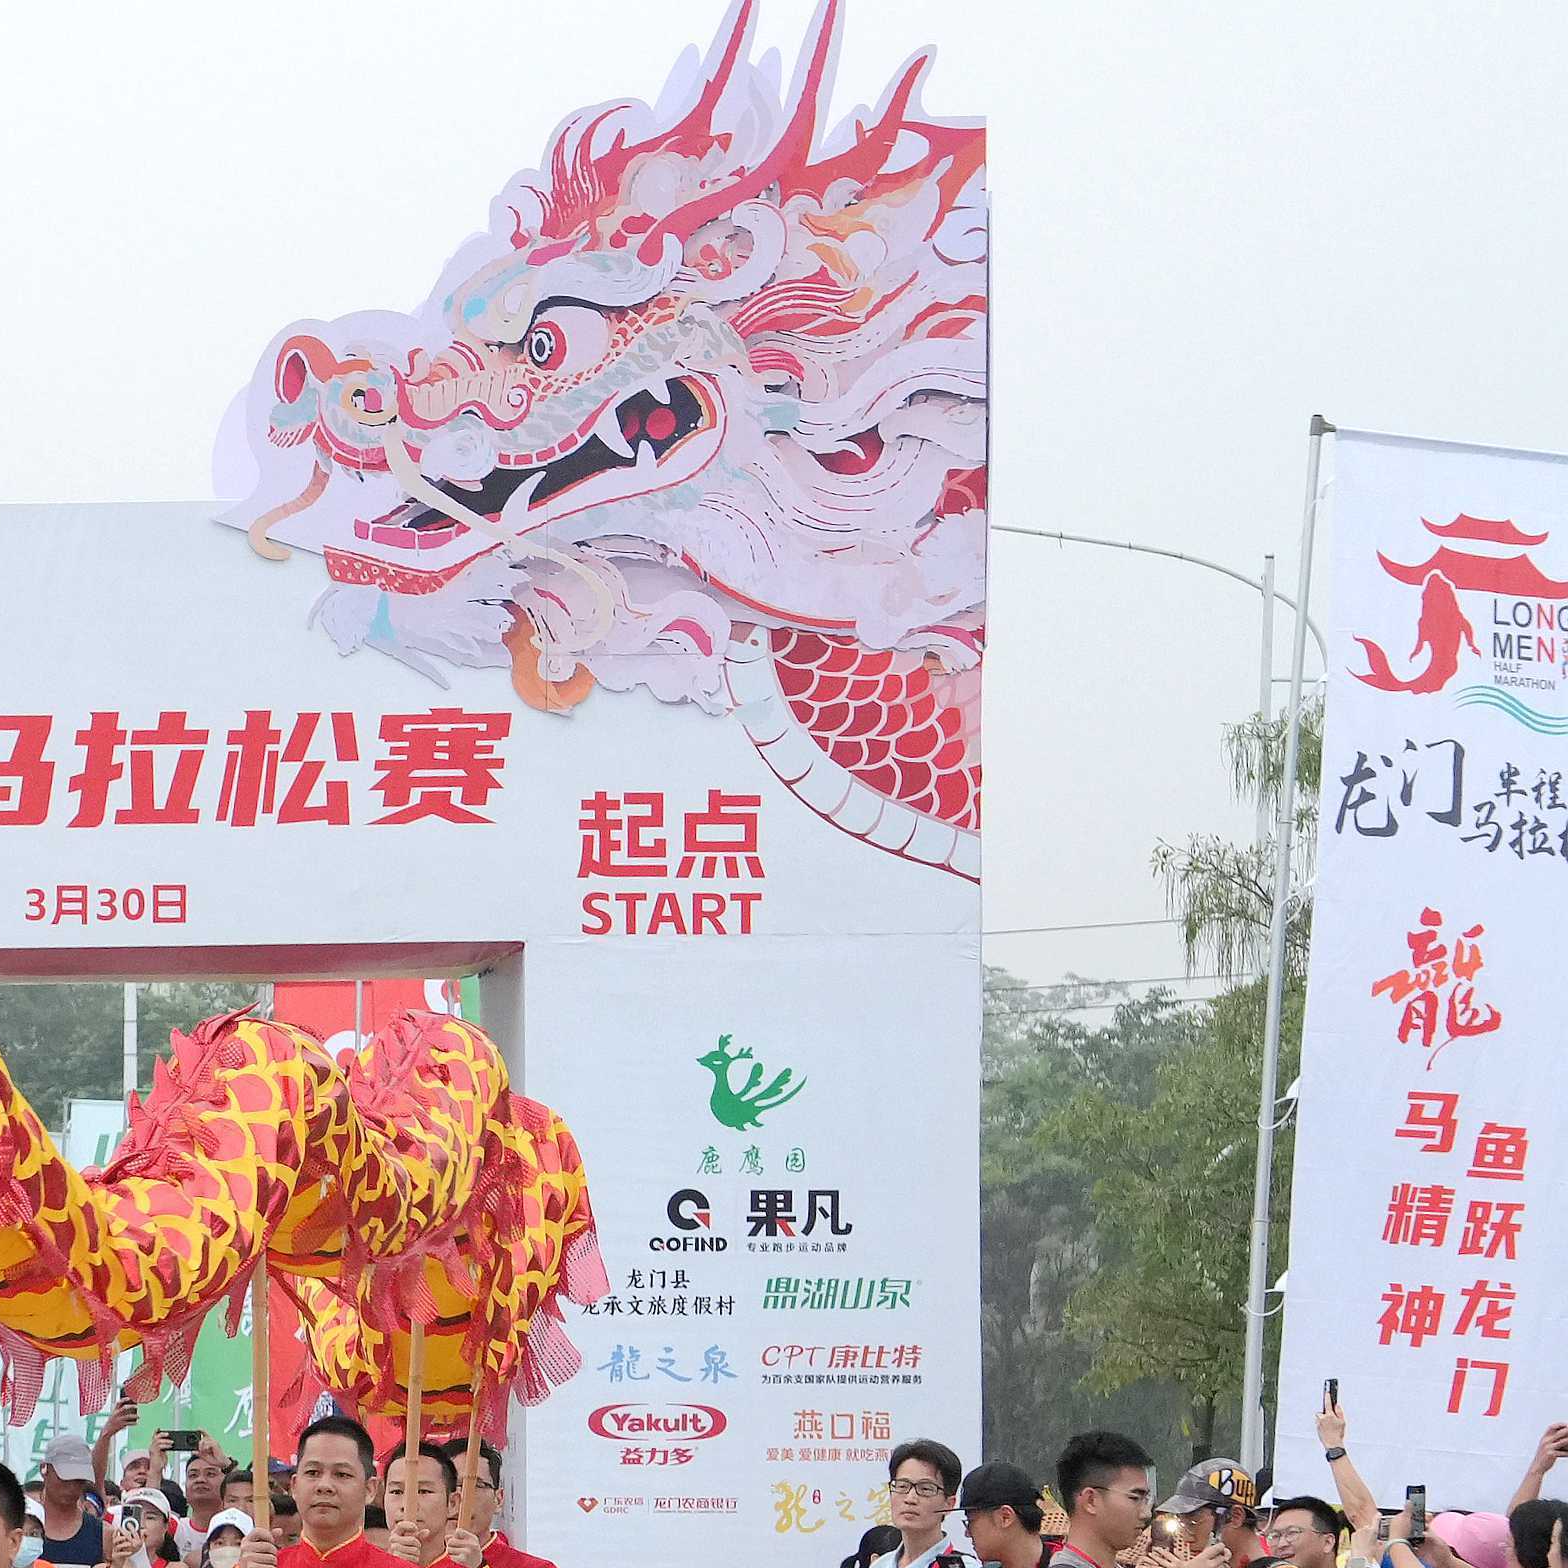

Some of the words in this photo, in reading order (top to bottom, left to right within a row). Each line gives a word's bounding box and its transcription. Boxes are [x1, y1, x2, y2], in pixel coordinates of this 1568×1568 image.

[1492, 632, 1555, 664] MEN
[1493, 662, 1522, 674] HALF
[1493, 674, 1556, 691] MARATHON
[1334, 738, 1465, 838] 龙门
[1494, 762, 1568, 810] 半程
[576, 787, 766, 881] 起点
[1460, 801, 1568, 861] 马拉
[24, 883, 188, 927] 3月30日
[580, 891, 762, 936] START
[696, 1144, 808, 1176] 鹿鹰园
[746, 1189, 854, 1238] 果凡
[747, 1242, 848, 1253] 专业跑步运动品牌
[627, 1269, 691, 1290] 龙门县
[1447, 1121, 1527, 1416] 鱼跃龙门
[581, 1295, 736, 1317] 龙承文旅度假村
[763, 1277, 912, 1311] 鼎湖山泉
[610, 1412, 708, 1433] Yakult
[792, 1409, 893, 1440] 燕口福
[619, 1447, 695, 1466] 益力多
[766, 1447, 794, 1462] 爱美
[846, 1447, 892, 1462] 就吃燕
[654, 1496, 737, 1510] 龙门农商银行
